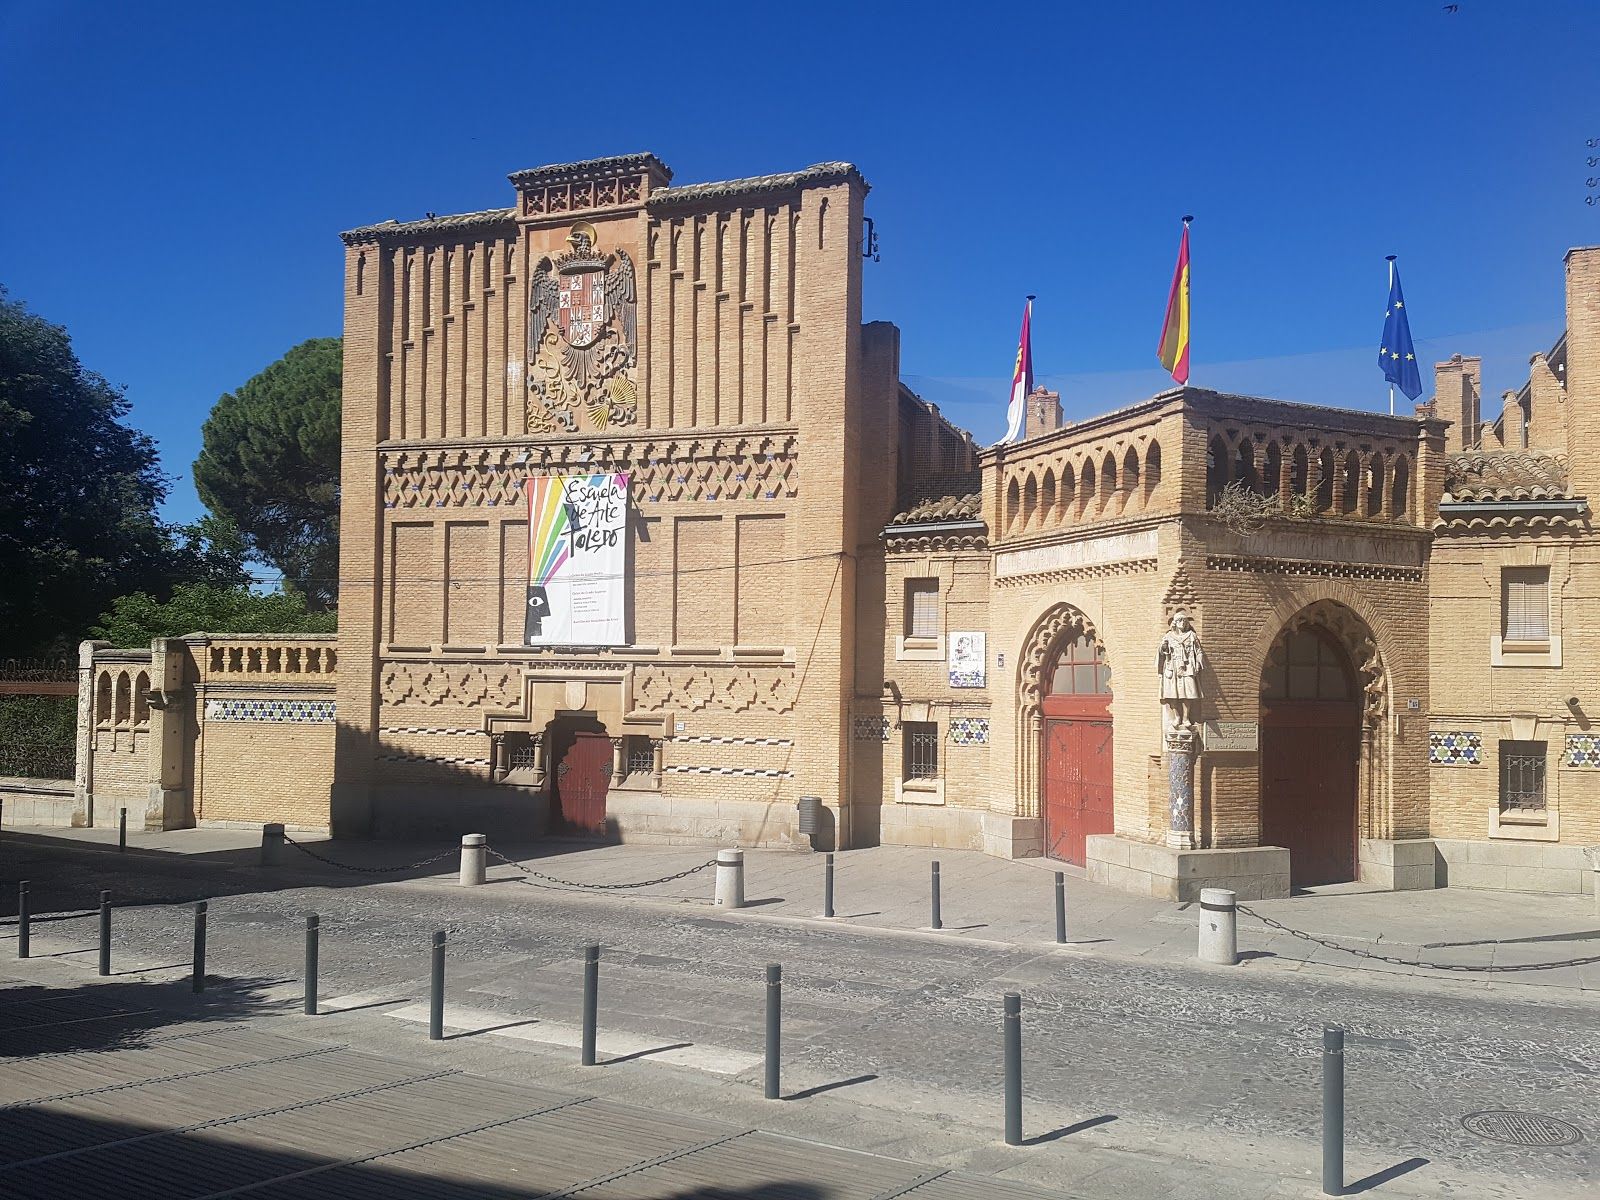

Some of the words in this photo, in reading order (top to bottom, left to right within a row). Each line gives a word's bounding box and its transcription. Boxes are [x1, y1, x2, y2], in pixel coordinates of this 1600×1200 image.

[565, 476, 626, 504] Escuela
[571, 505, 587, 521] de
[588, 501, 620, 528] Arte
